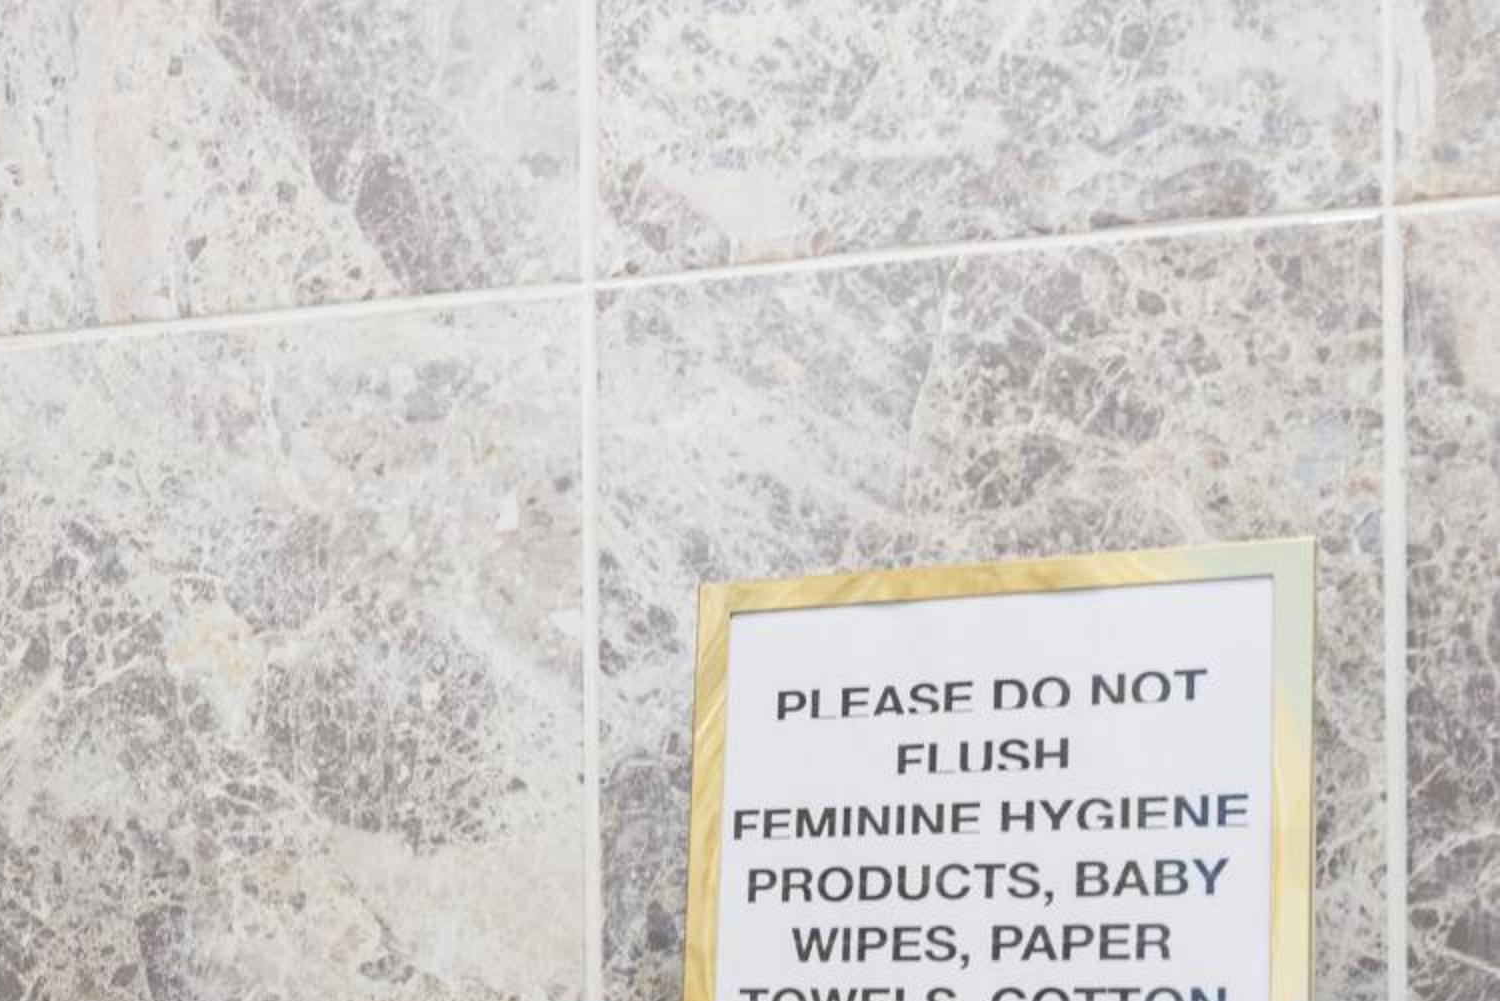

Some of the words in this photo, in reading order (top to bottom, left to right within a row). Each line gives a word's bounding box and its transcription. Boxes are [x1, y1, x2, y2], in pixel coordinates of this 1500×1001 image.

[777, 680, 974, 721] PLEASE
[993, 676, 1071, 710] DO
[1091, 668, 1208, 706] NOT
[897, 737, 1069, 775] FLUSH
[733, 802, 981, 841] FEMININE
[1000, 793, 1249, 833] HYGIENE
[747, 861, 1054, 907] PRODUCTS,
[1075, 858, 1229, 898] BABY
[791, 924, 970, 970] WIPES,
[991, 923, 1171, 962] PAPER
